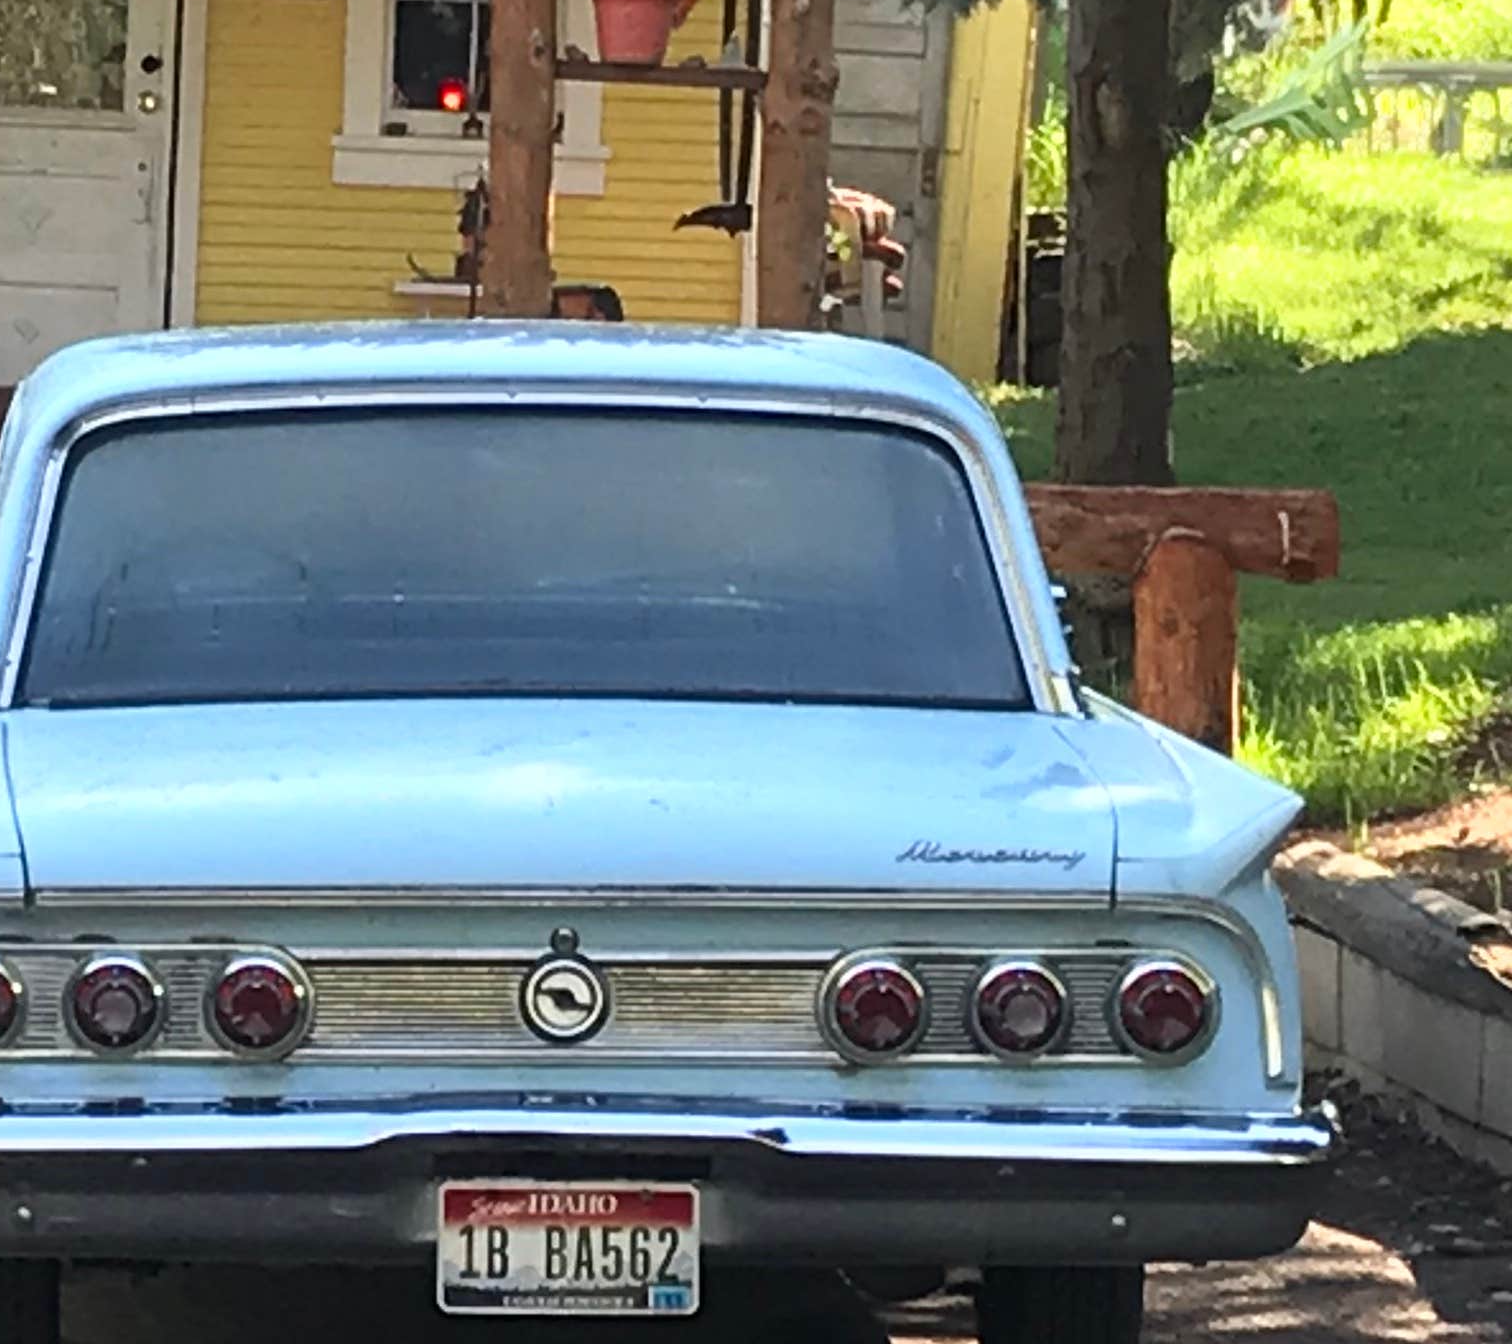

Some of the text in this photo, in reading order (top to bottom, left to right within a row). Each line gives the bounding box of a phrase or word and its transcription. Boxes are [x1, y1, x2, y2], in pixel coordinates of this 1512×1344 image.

[527, 1193, 619, 1215] IDAHO
[458, 1224, 680, 1281] 1B BA562
